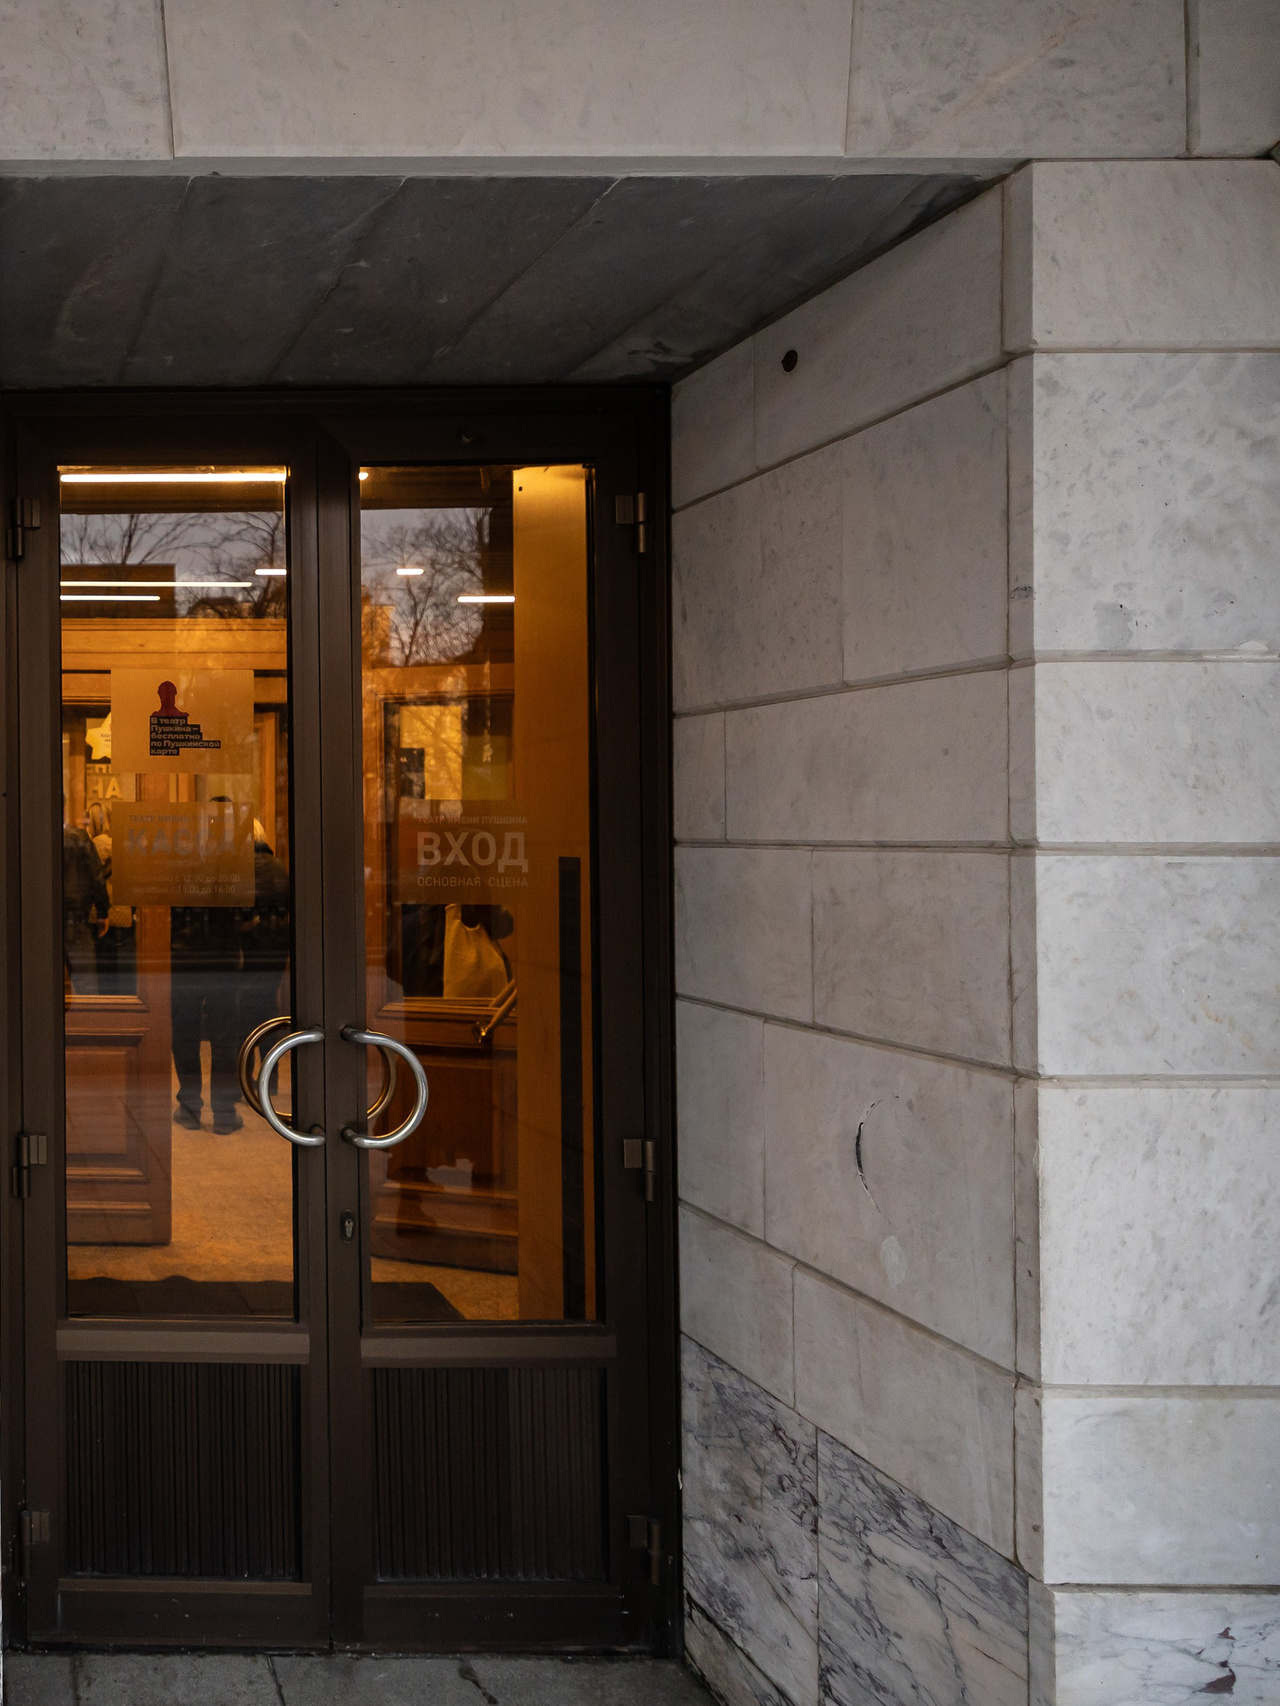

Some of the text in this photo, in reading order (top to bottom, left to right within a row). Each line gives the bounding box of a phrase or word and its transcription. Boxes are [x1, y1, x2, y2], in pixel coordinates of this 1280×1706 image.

[159, 718, 186, 726] театр
[418, 816, 445, 824] ТЕАТР
[482, 816, 528, 824] ПУШКИНА
[417, 832, 529, 873] ВХОД
[417, 876, 528, 888] ОСНОВНАЯ СЦЕНА
